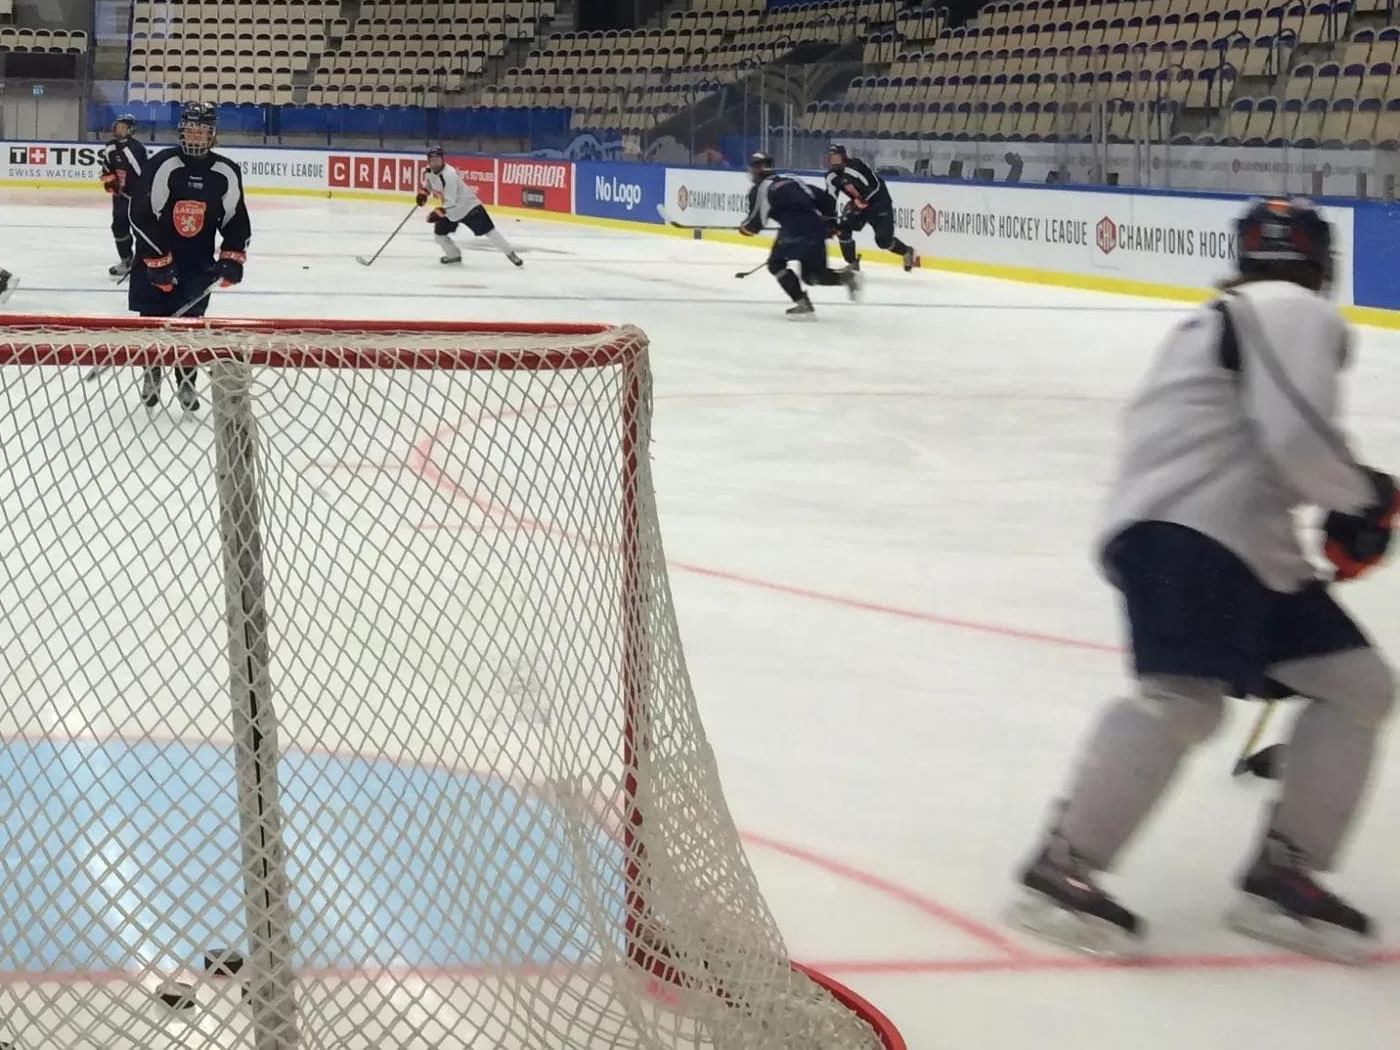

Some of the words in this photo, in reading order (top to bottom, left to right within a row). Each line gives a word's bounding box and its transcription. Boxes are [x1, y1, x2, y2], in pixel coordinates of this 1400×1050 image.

[9, 168, 41, 177] SWISS
[45, 170, 94, 179] WATCHES
[251, 161, 288, 176] HOCKEY
[291, 163, 324, 179] LEAGUE
[502, 163, 566, 188] WARRIOR
[596, 175, 611, 201] No
[613, 176, 642, 210] Logo
[688, 189, 725, 211] CHAMPIONS
[937, 210, 996, 237] CHAMPIONS
[999, 215, 1041, 241] HOCKEY
[1045, 218, 1088, 246] LEAGUE
[1118, 224, 1194, 256] CHAMPIONS
